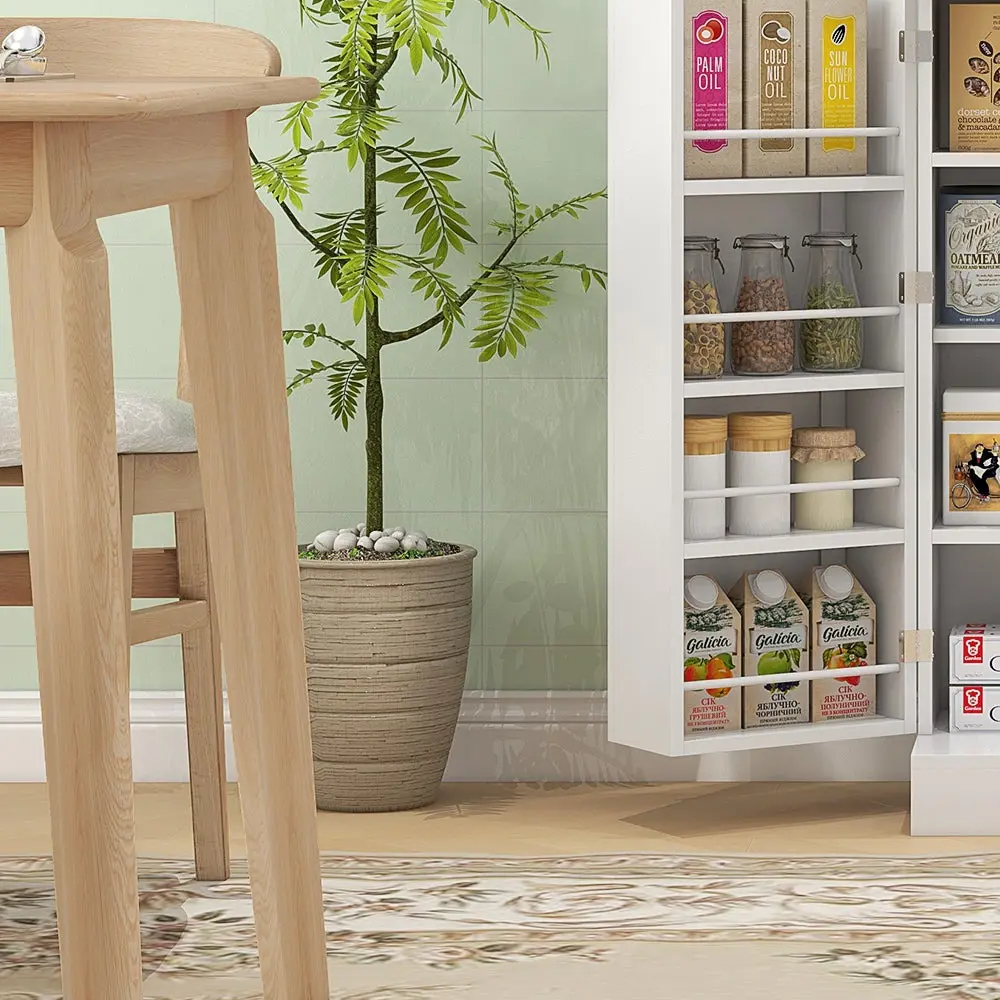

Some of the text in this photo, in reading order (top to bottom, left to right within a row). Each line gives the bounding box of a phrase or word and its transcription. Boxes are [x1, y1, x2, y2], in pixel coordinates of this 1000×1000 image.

[696, 56, 723, 73] PALM
[763, 48, 788, 65] COCO
[829, 50, 848, 66] SUN
[766, 65, 785, 81] NUT
[824, 67, 853, 83] FLOWER
[698, 73, 722, 90] OIL
[765, 82, 788, 98] OIL
[827, 84, 850, 100] OIL
[957, 108, 990, 117] dorset
[957, 116, 997, 124] chocolate
[755, 632, 802, 650] Galicia
[822, 624, 869, 642] Galicia
[686, 636, 732, 654] Galicia
[771, 693, 787, 701] СІК
[838, 685, 853, 694] СІК
[701, 697, 716, 706] СІК
